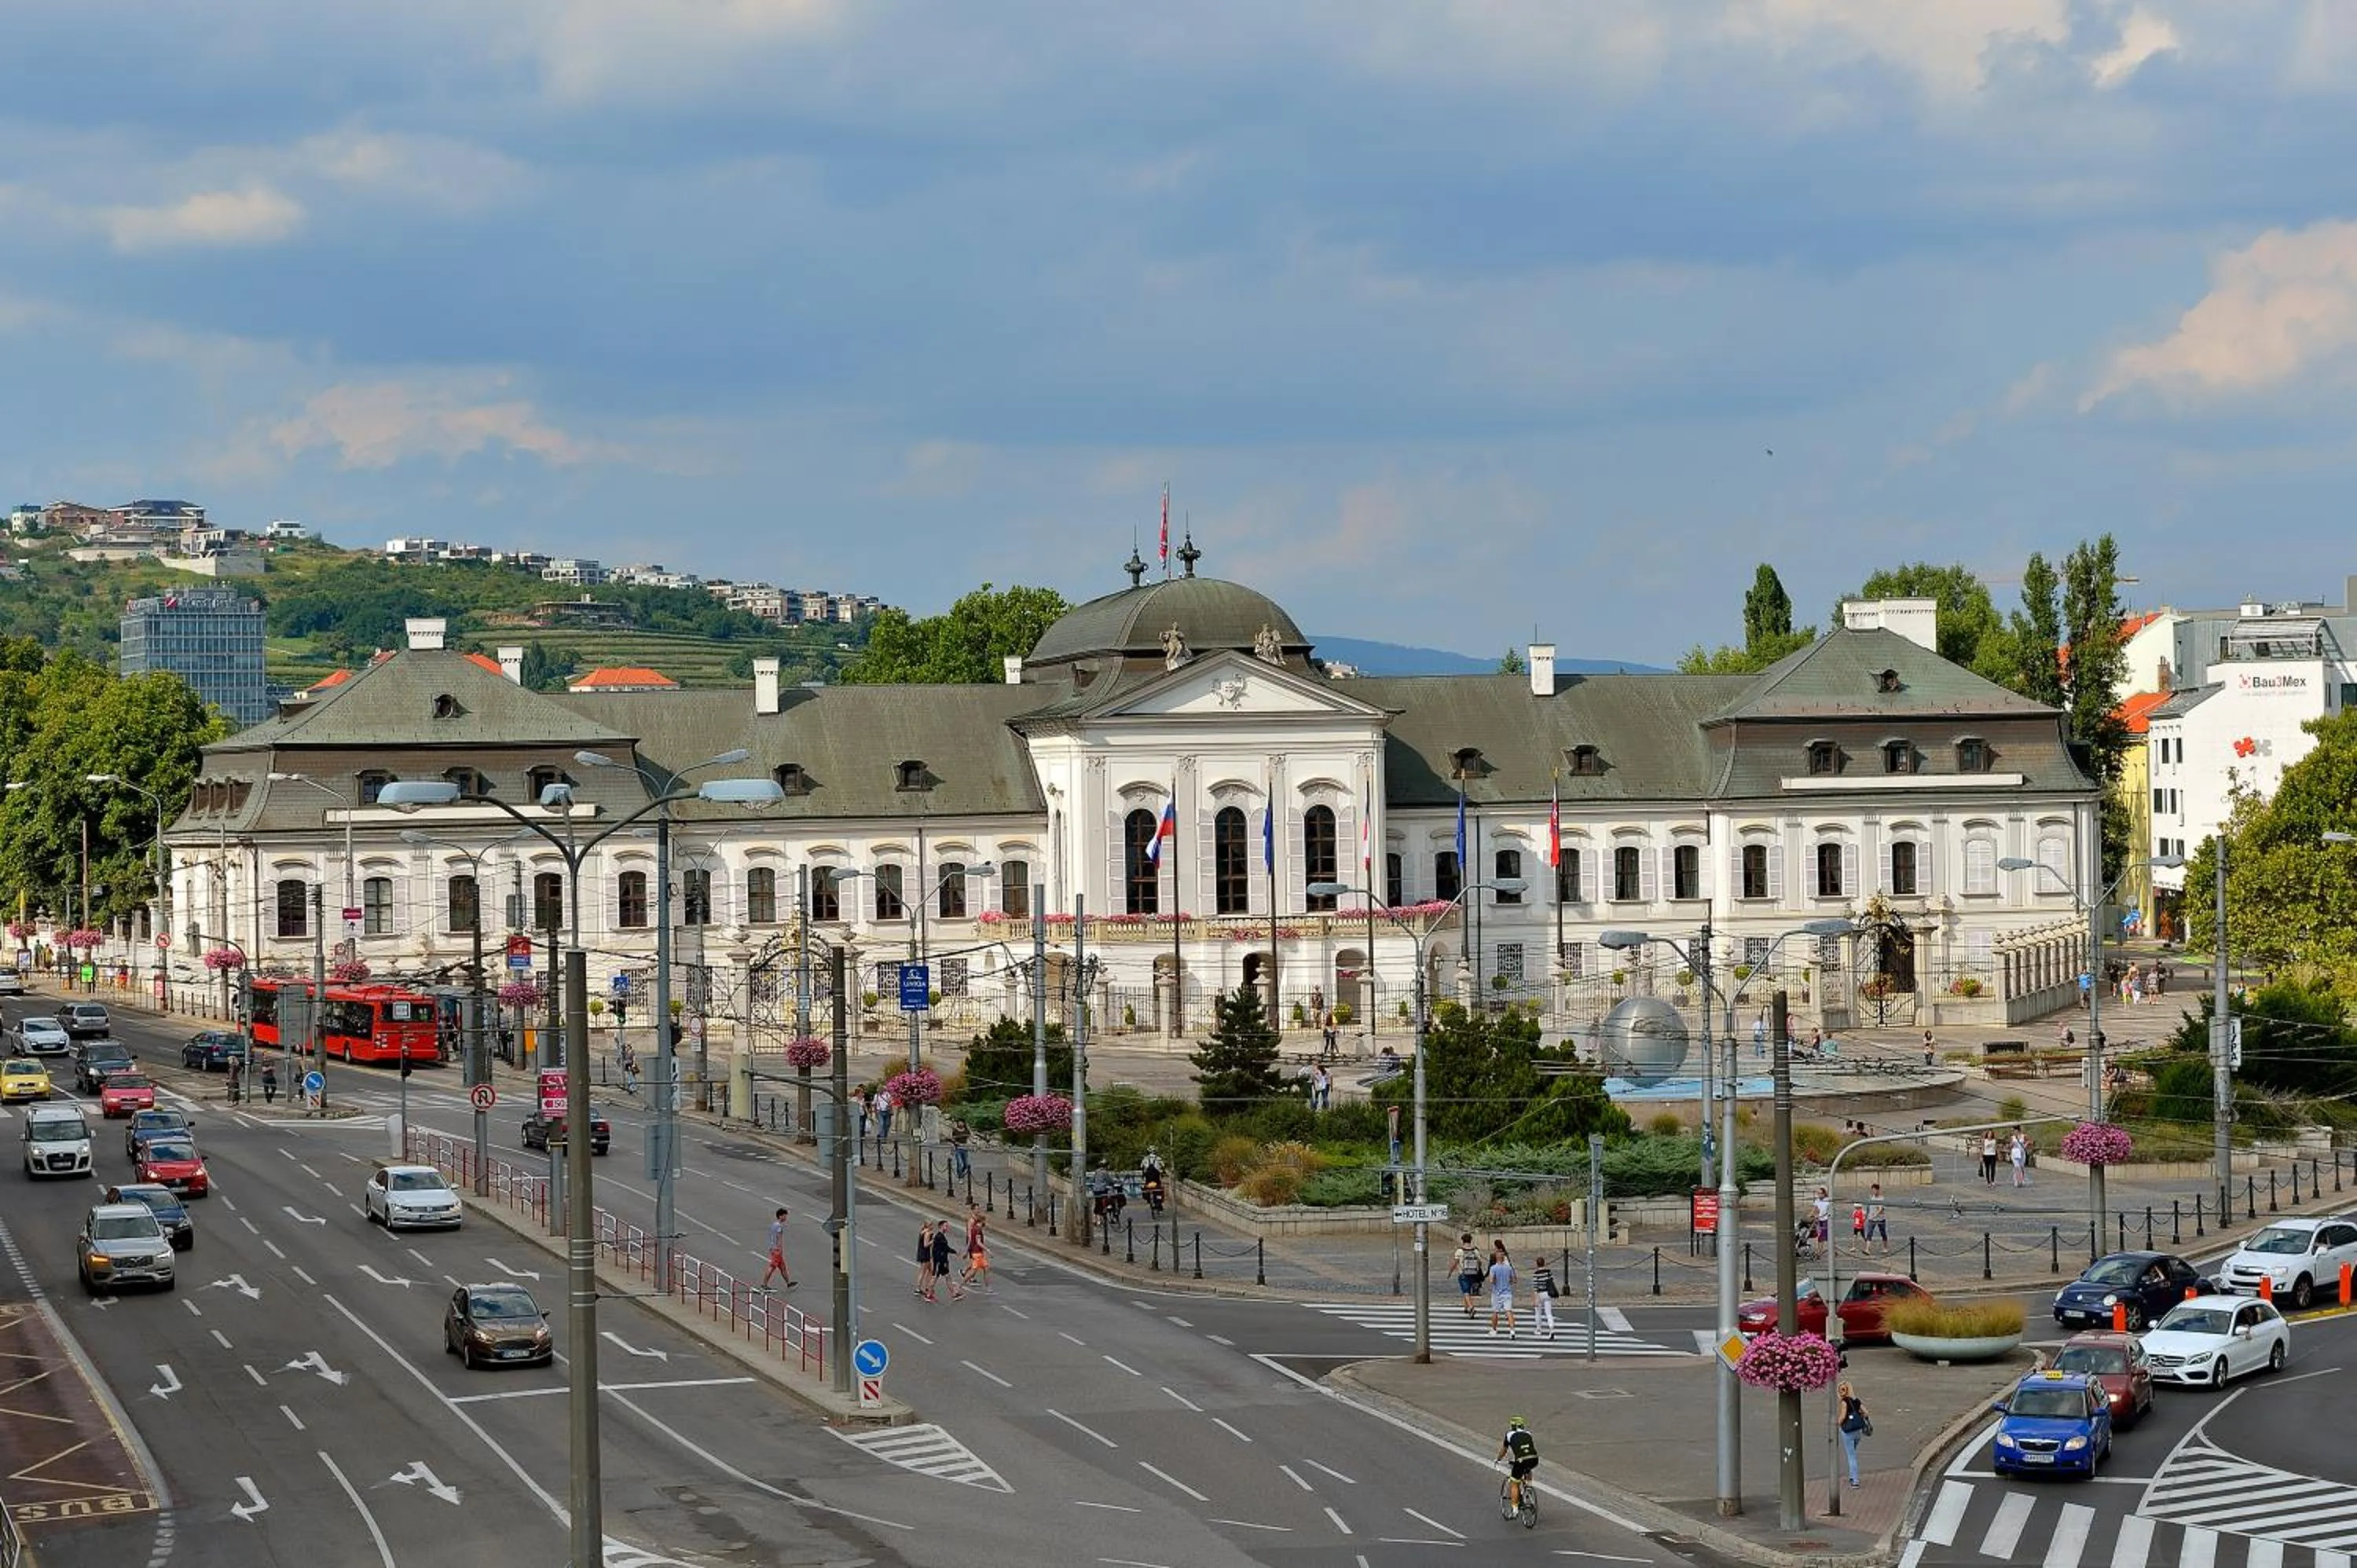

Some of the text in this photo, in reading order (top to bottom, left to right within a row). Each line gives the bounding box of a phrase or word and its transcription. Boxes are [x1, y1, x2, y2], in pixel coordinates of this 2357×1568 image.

[2252, 675, 2308, 688] Bau3Mex
[1402, 1209, 1428, 1218] HOTEL
[16, 1496, 134, 1520] BUS
